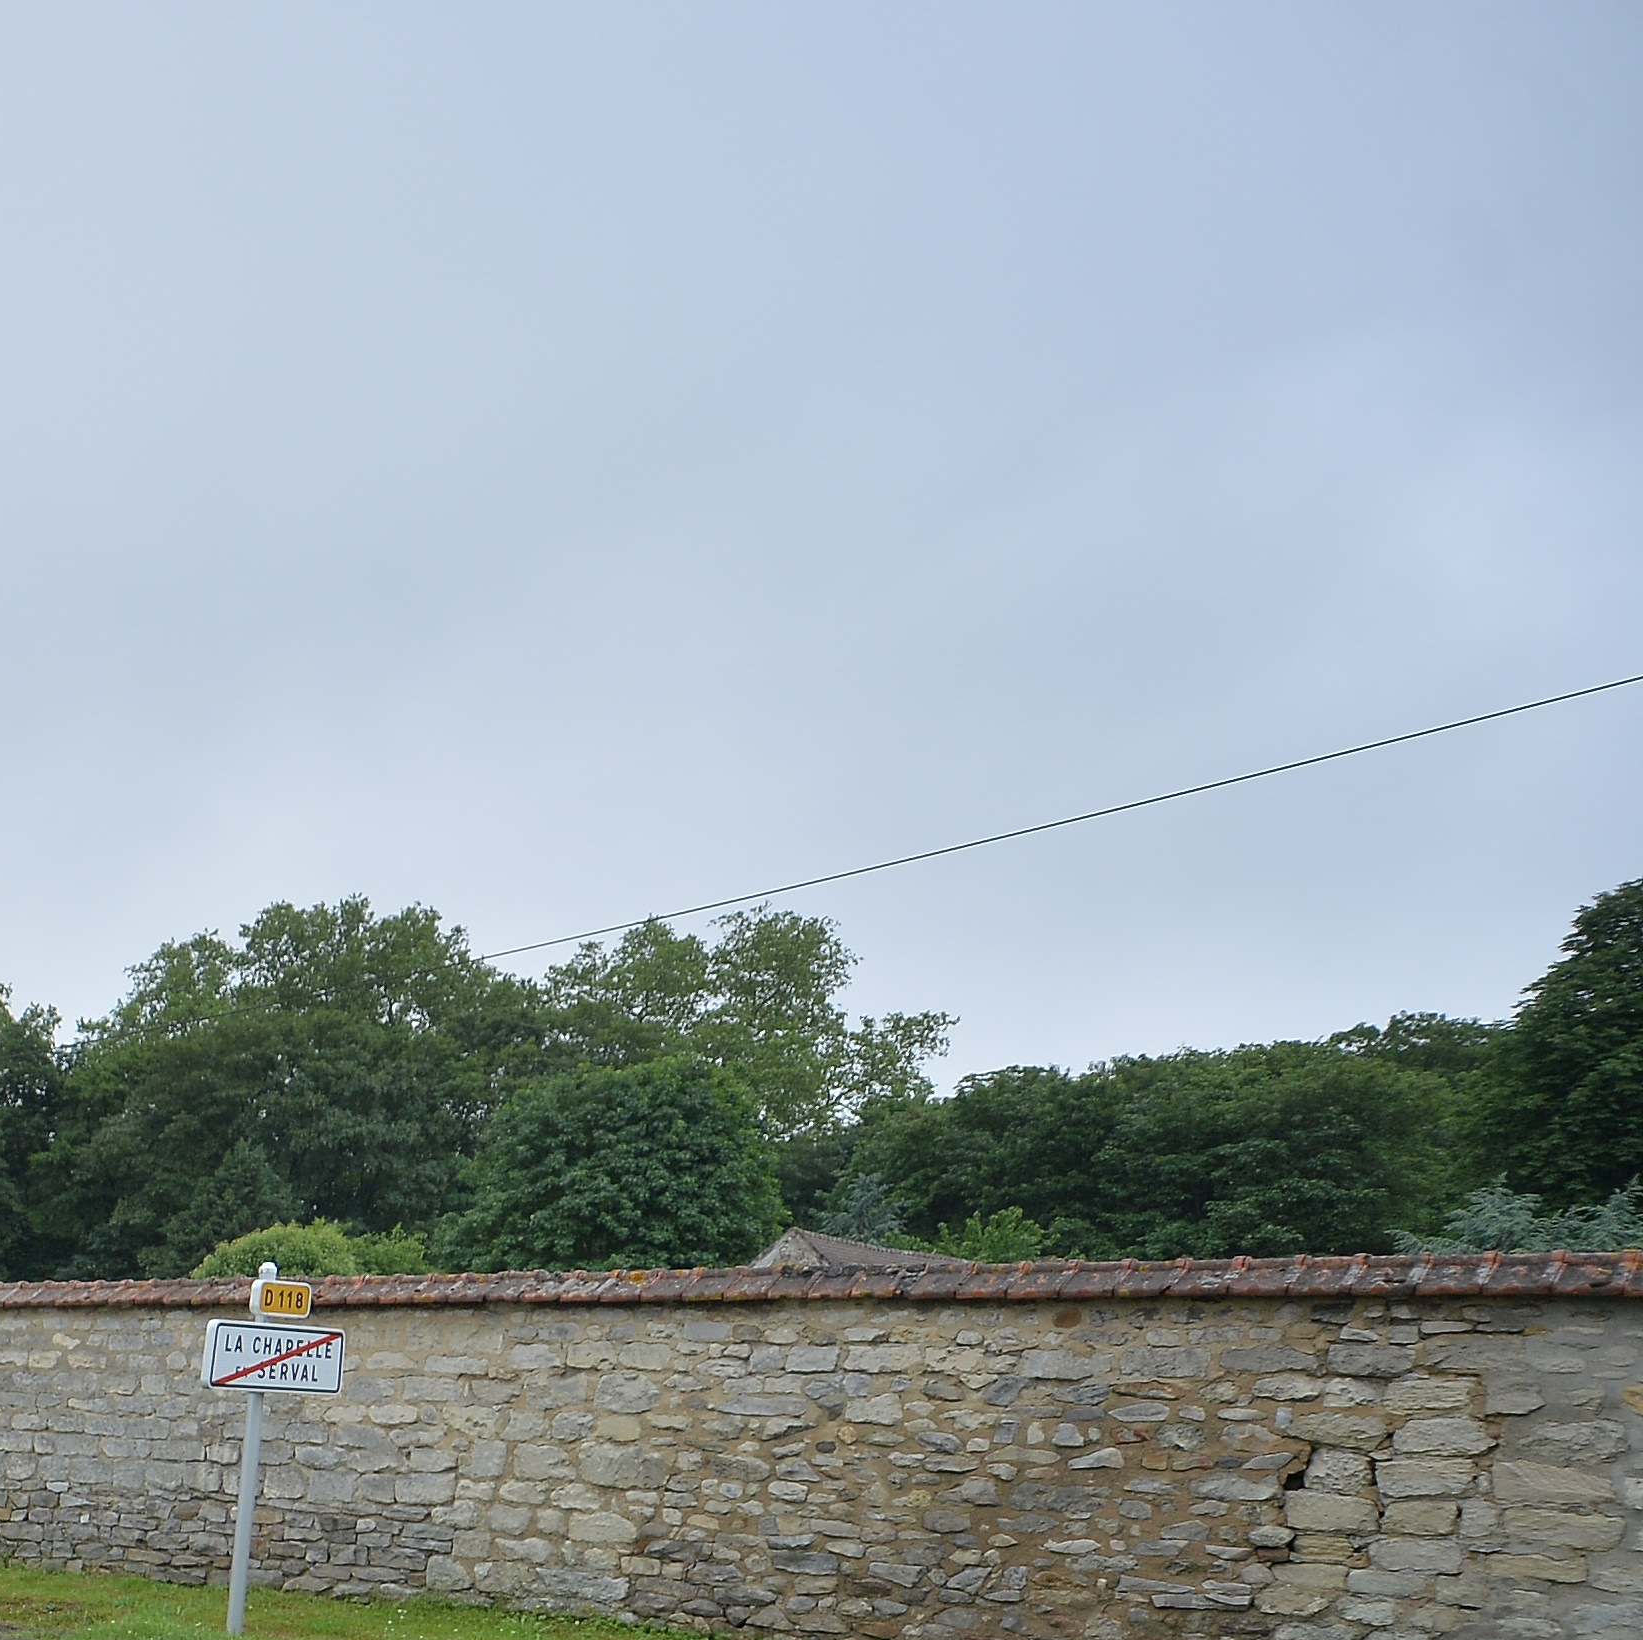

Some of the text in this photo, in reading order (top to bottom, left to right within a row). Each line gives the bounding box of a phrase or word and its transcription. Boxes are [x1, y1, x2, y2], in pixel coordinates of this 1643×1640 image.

[264, 1289, 303, 1309] D 118
[225, 1334, 333, 1359] LA CHAPELLE
[257, 1362, 318, 1382] SERVAL
